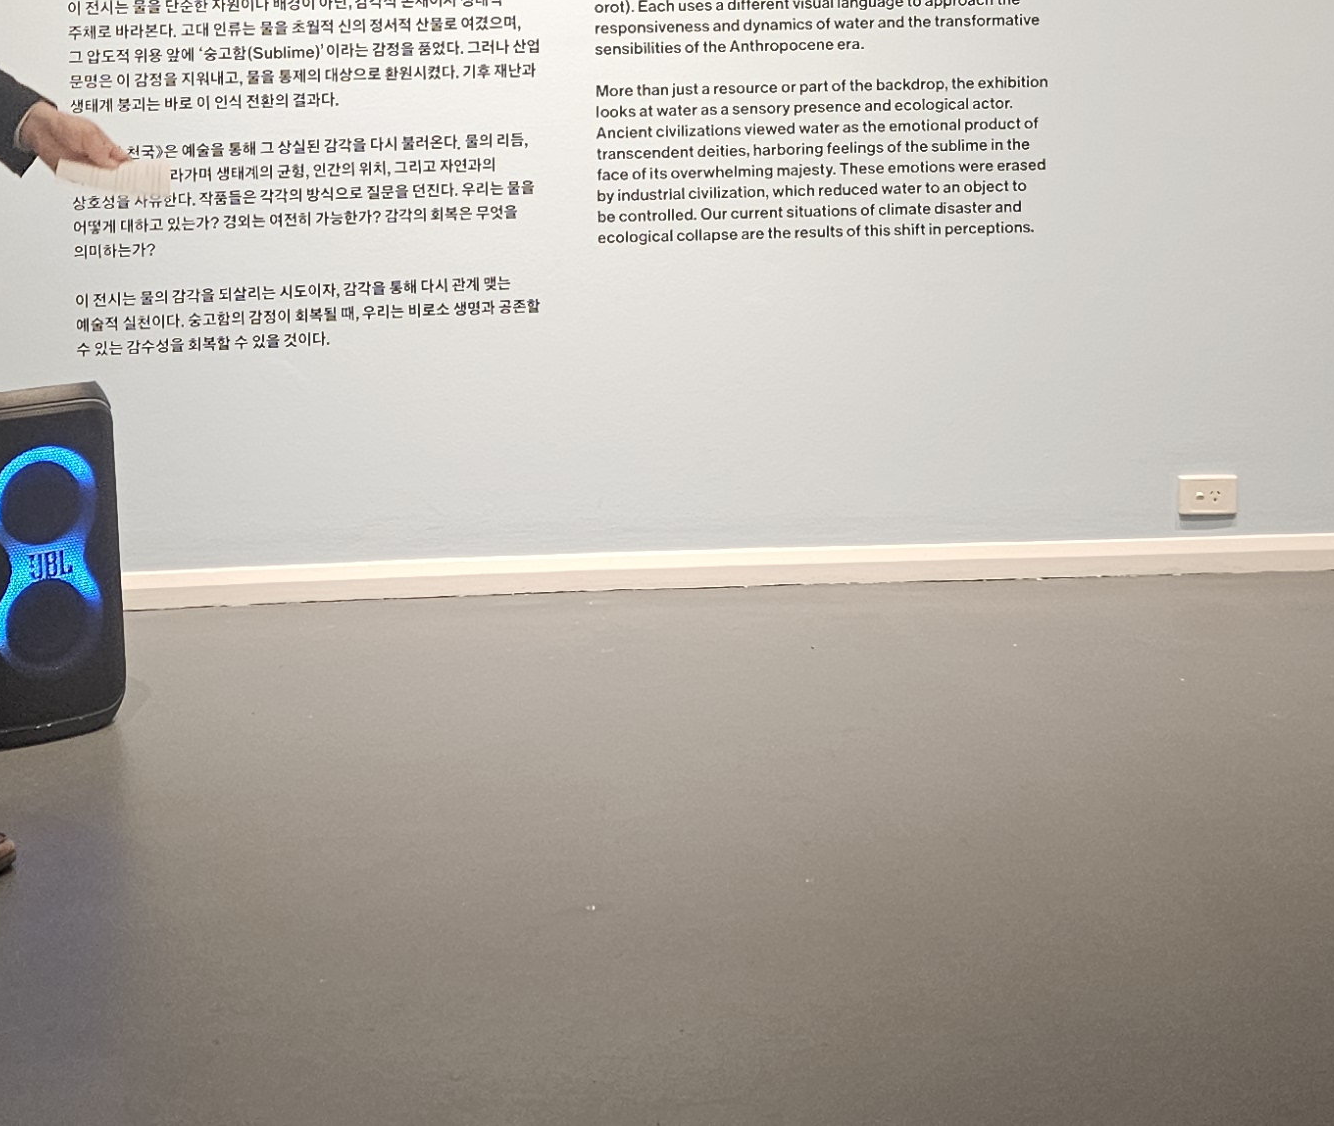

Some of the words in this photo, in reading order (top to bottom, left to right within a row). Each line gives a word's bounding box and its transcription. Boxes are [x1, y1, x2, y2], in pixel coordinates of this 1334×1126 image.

[595, 41, 681, 55] sensibilities
[684, 41, 700, 53] of
[702, 41, 727, 52] the
[730, 40, 834, 54] Anthropocene
[837, 41, 864, 50] era.
[71, 98, 112, 113] 생태계
[117, 97, 160, 112] 붕괴는
[165, 96, 193, 111] 바로
[196, 95, 210, 110] 이
[215, 94, 241, 109] 인식
[246, 93, 288, 108] 전환의
[293, 92, 339, 107] 결과다.
[182, 143, 224, 158] 예술을
[229, 141, 255, 156] 통해
[259, 142, 275, 153] 그
[278, 139, 319, 154] 상실된
[324, 138, 366, 153] 감각을
[371, 136, 397, 151] 다시
[402, 134, 460, 150] 불러온다.
[465, 133, 492, 148] 물의
[497, 133, 528, 148] 리듬,
[74, 219, 115, 235] 어떻게
[121, 218, 163, 233] 대하고
[168, 215, 219, 231] 있는가?
[224, 214, 265, 229] 경외는
[270, 212, 310, 227] 여전히
[316, 210, 381, 226] 가능한가?
[385, 208, 426, 223] 감각의
[431, 207, 472, 221] 회복은
[476, 205, 517, 220] 무엇을
[75, 242, 155, 259] 의미하는가?
[76, 343, 91, 357] 수
[95, 341, 123, 356] 있는
[127, 338, 184, 354] 감수성을
[189, 336, 230, 351] 회복할
[234, 335, 249, 350] 수
[252, 334, 280, 349] 있을
[284, 331, 329, 347] 것이다.
[27, 550, 74, 579] JBL
